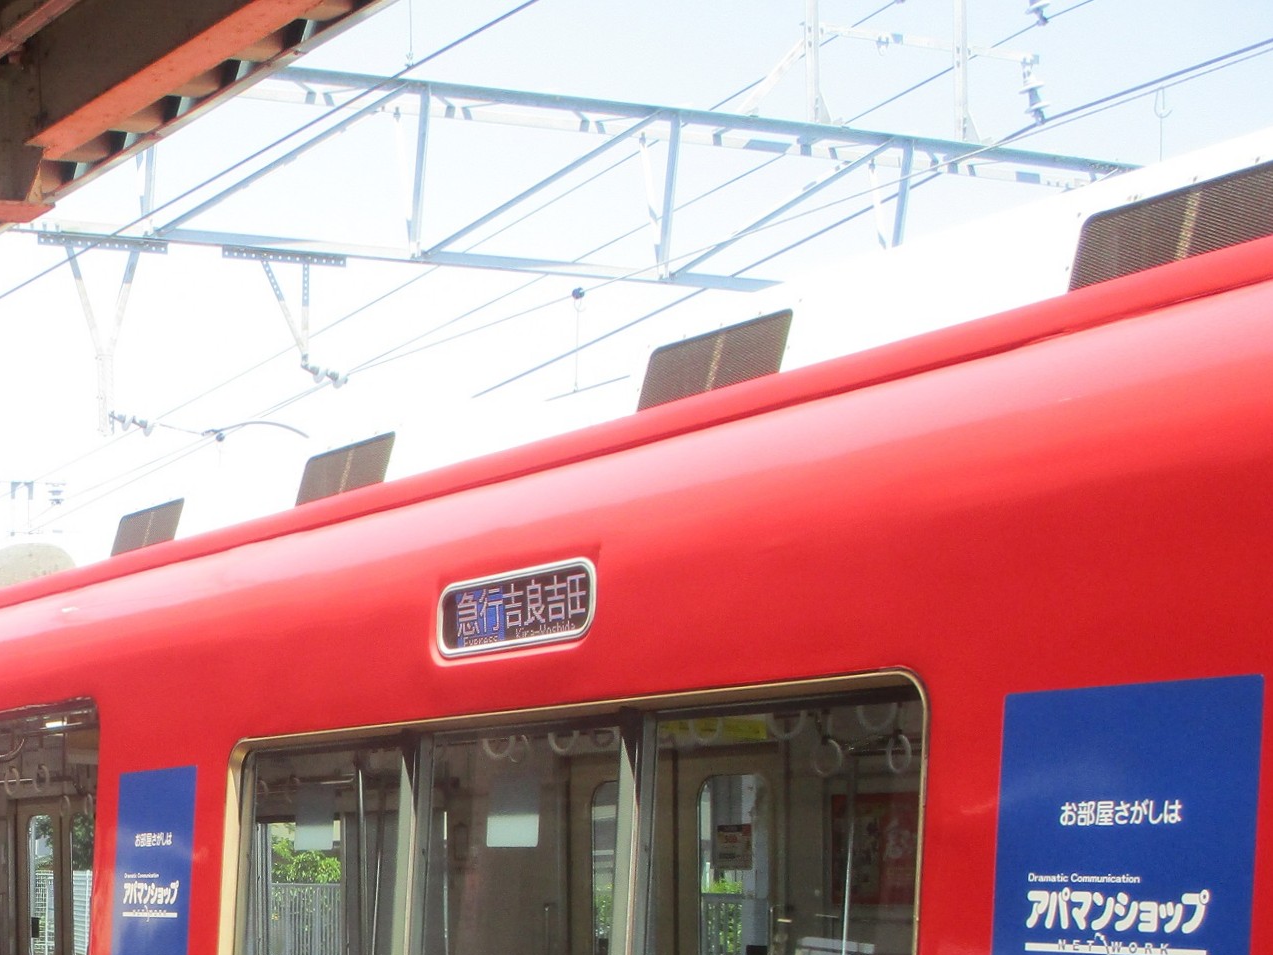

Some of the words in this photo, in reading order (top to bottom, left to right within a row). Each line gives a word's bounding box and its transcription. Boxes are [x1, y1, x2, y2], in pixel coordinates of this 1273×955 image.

[457, 587, 504, 637] 急行
[1060, 799, 1182, 826] お部屋さがしは
[134, 832, 172, 847] お部屋さがしは
[1027, 872, 1069, 883] Dramatic
[1070, 873, 1141, 884] Communication
[123, 880, 179, 905] アパマンショップ
[1026, 887, 1210, 934] アパマンショップ
